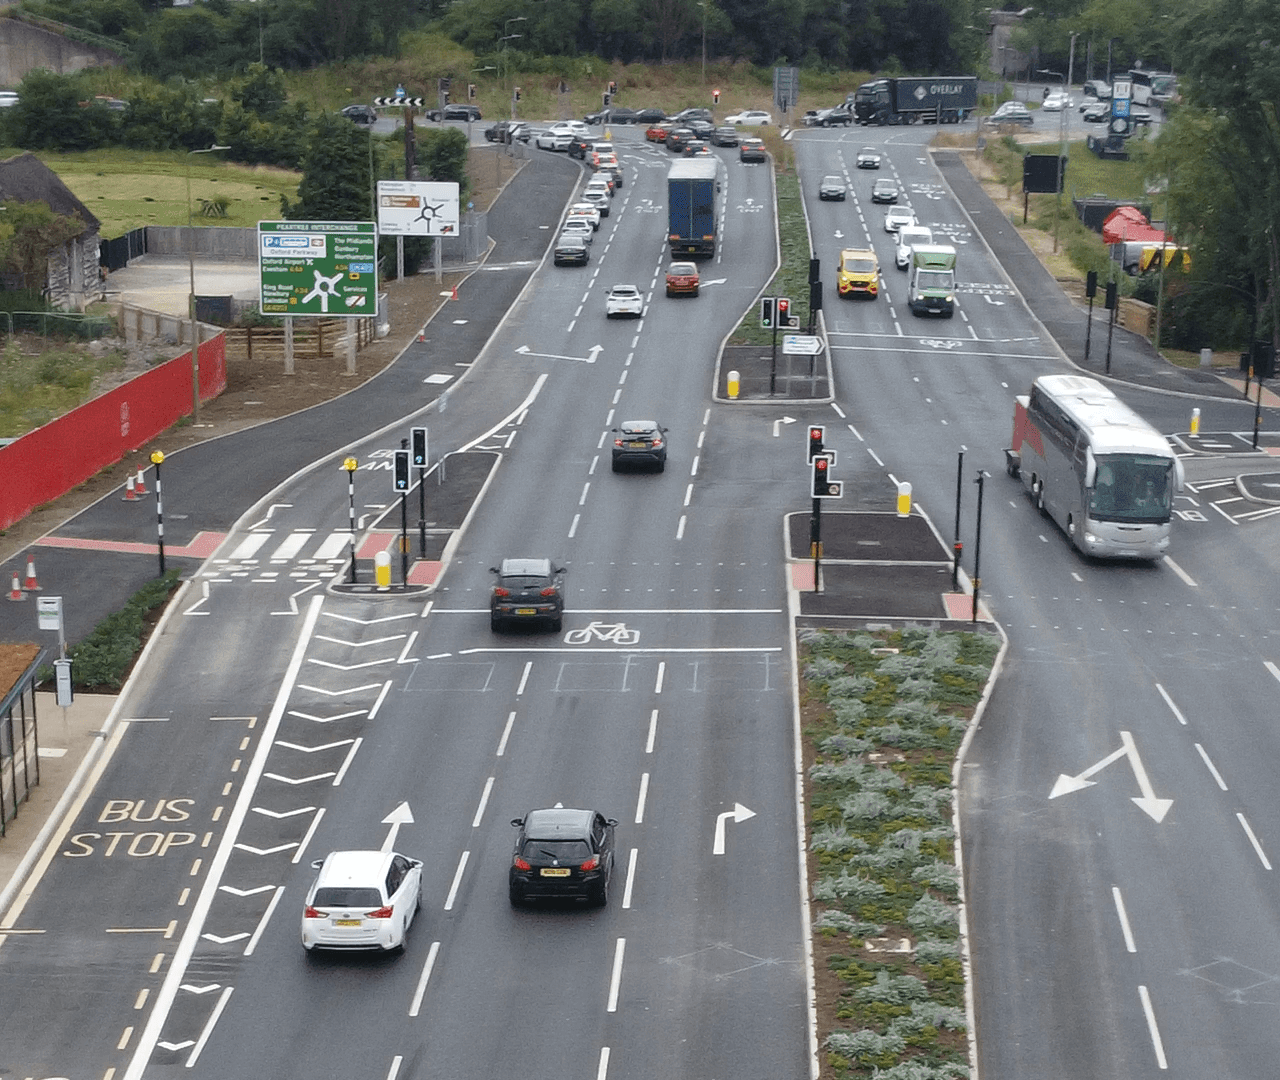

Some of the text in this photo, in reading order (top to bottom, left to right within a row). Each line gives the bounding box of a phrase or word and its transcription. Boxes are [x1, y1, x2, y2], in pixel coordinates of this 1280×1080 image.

[930, 85, 963, 94] OVERLAY
[98, 799, 195, 823] BUS
[63, 832, 197, 857] STOP
